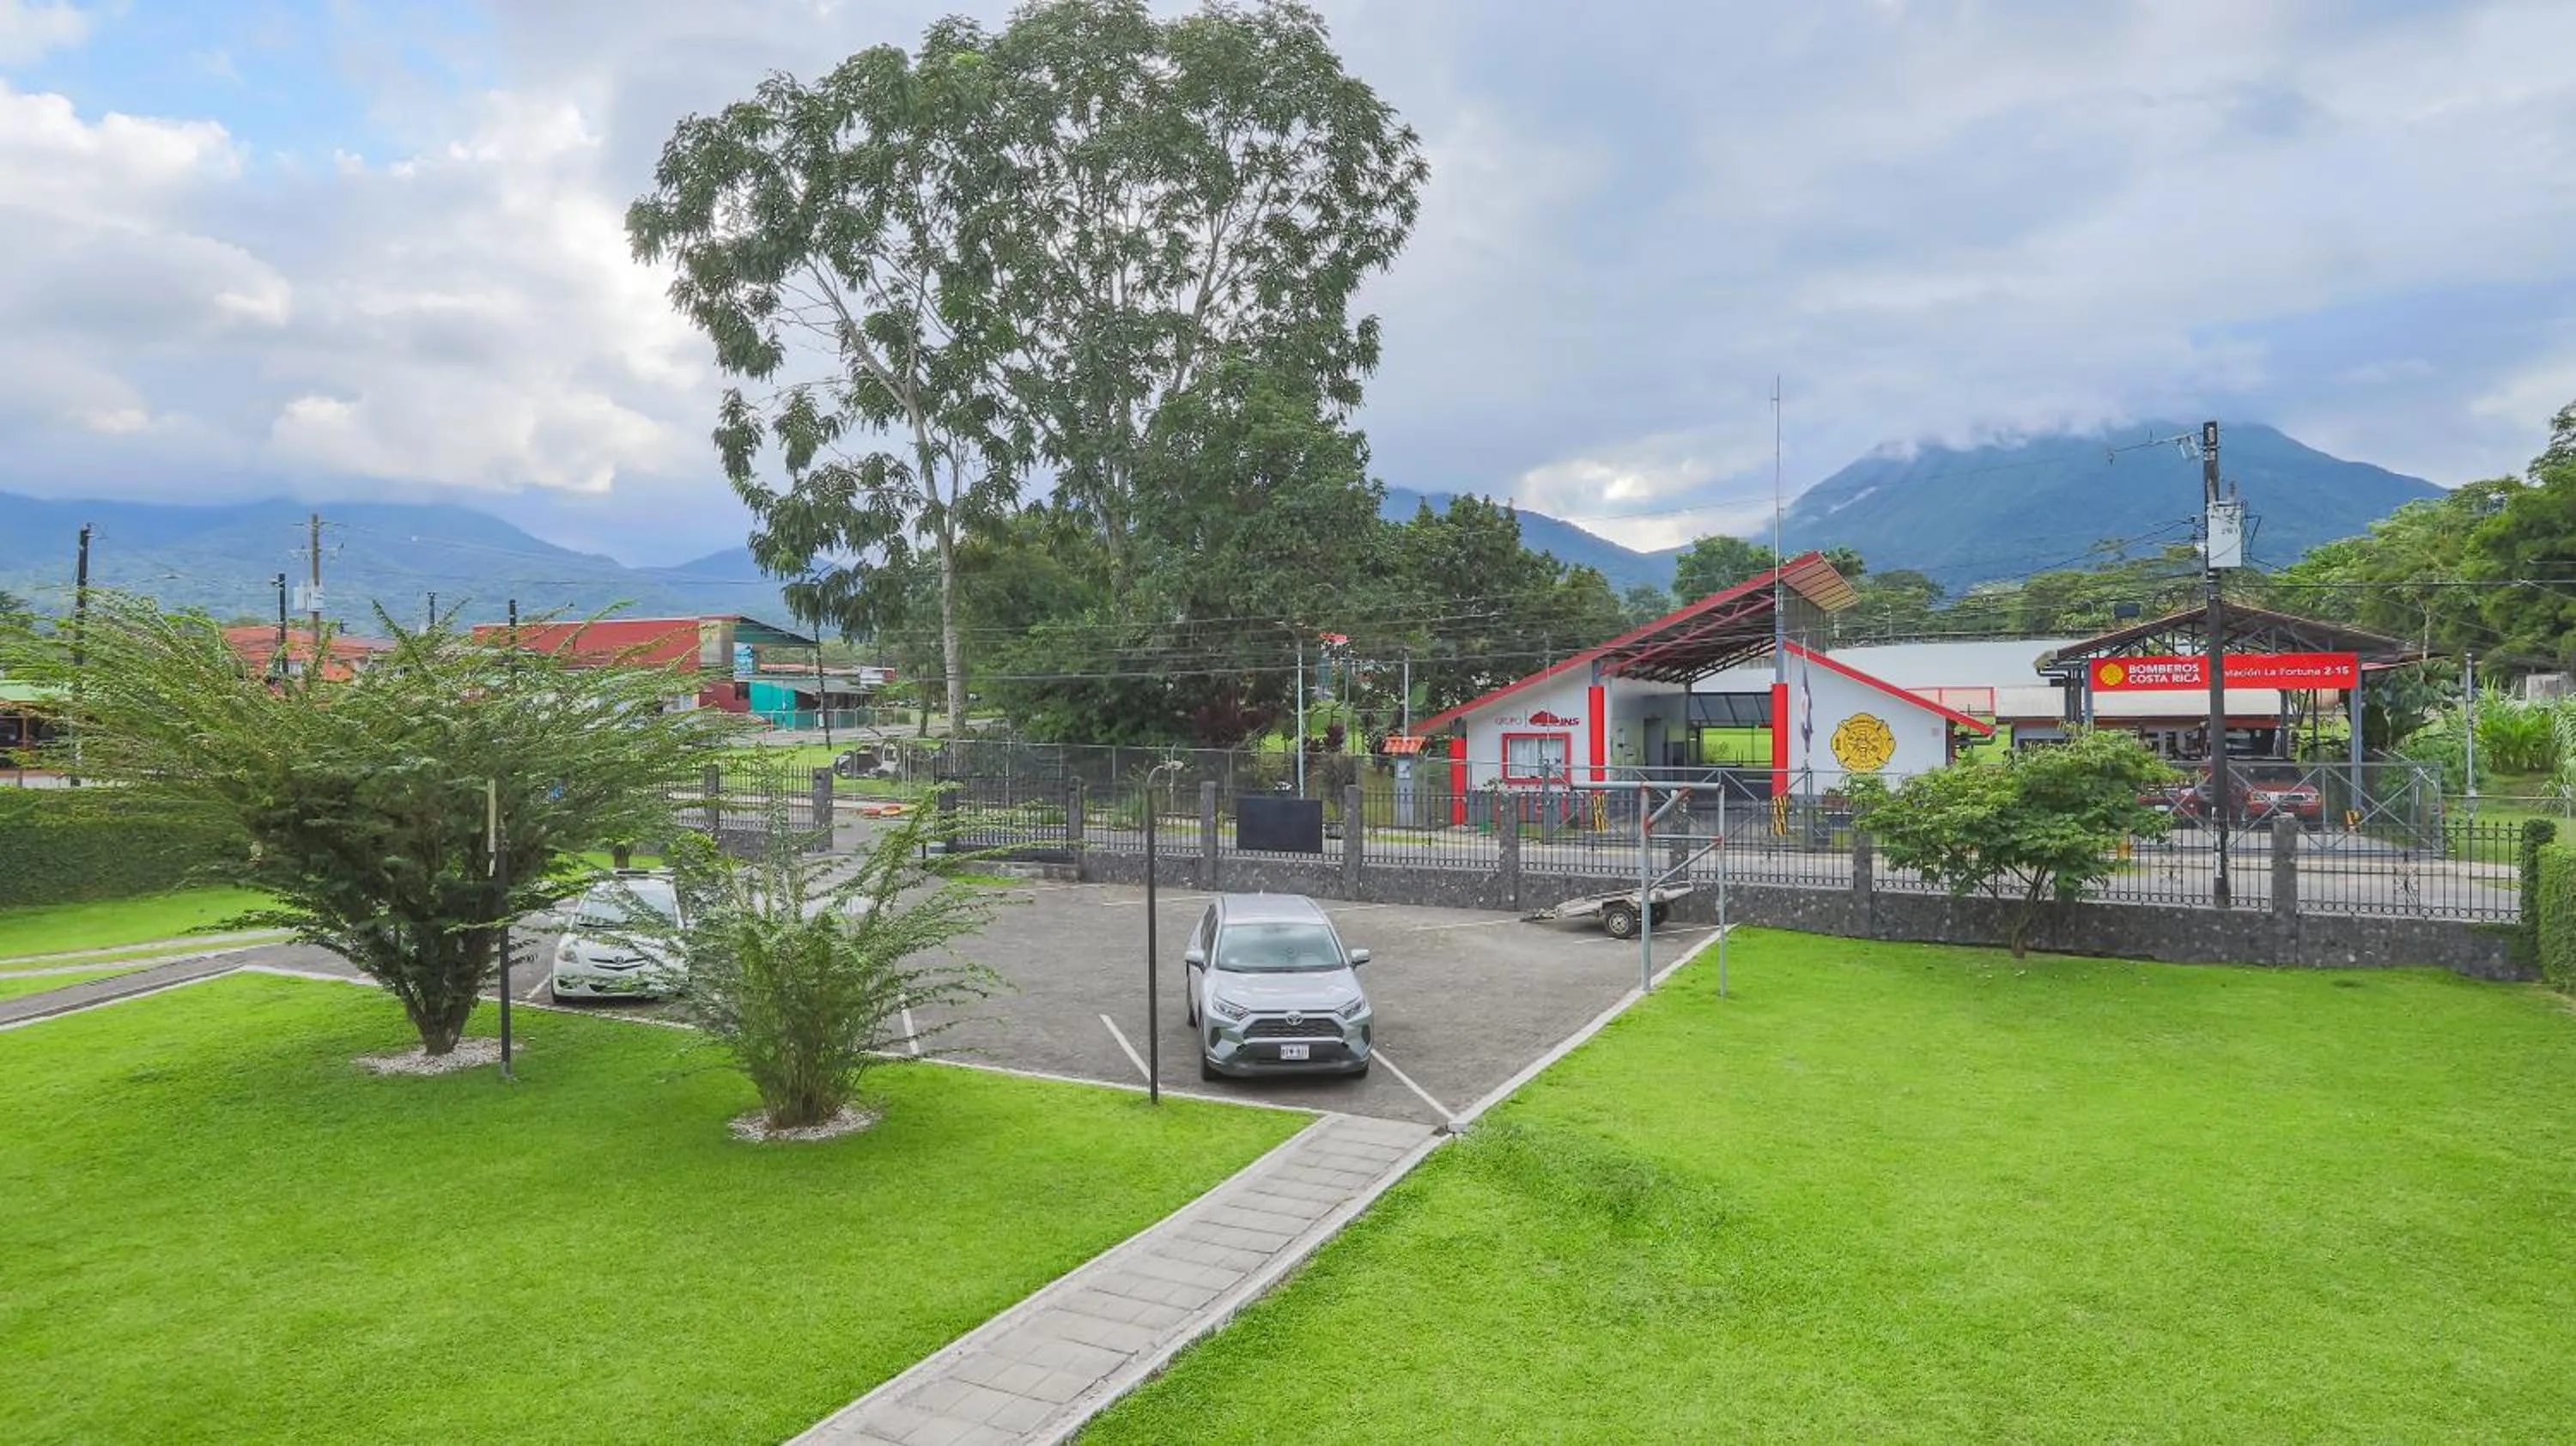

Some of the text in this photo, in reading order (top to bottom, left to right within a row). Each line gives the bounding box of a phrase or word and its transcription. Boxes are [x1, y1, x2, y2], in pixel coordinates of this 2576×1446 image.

[2129, 664, 2199, 674] BOMBEROS
[2225, 668, 2261, 677] stación
[2264, 667, 2276, 676] La
[2280, 667, 2321, 676] Fortuna
[2129, 673, 2201, 684] COSTA RICA
